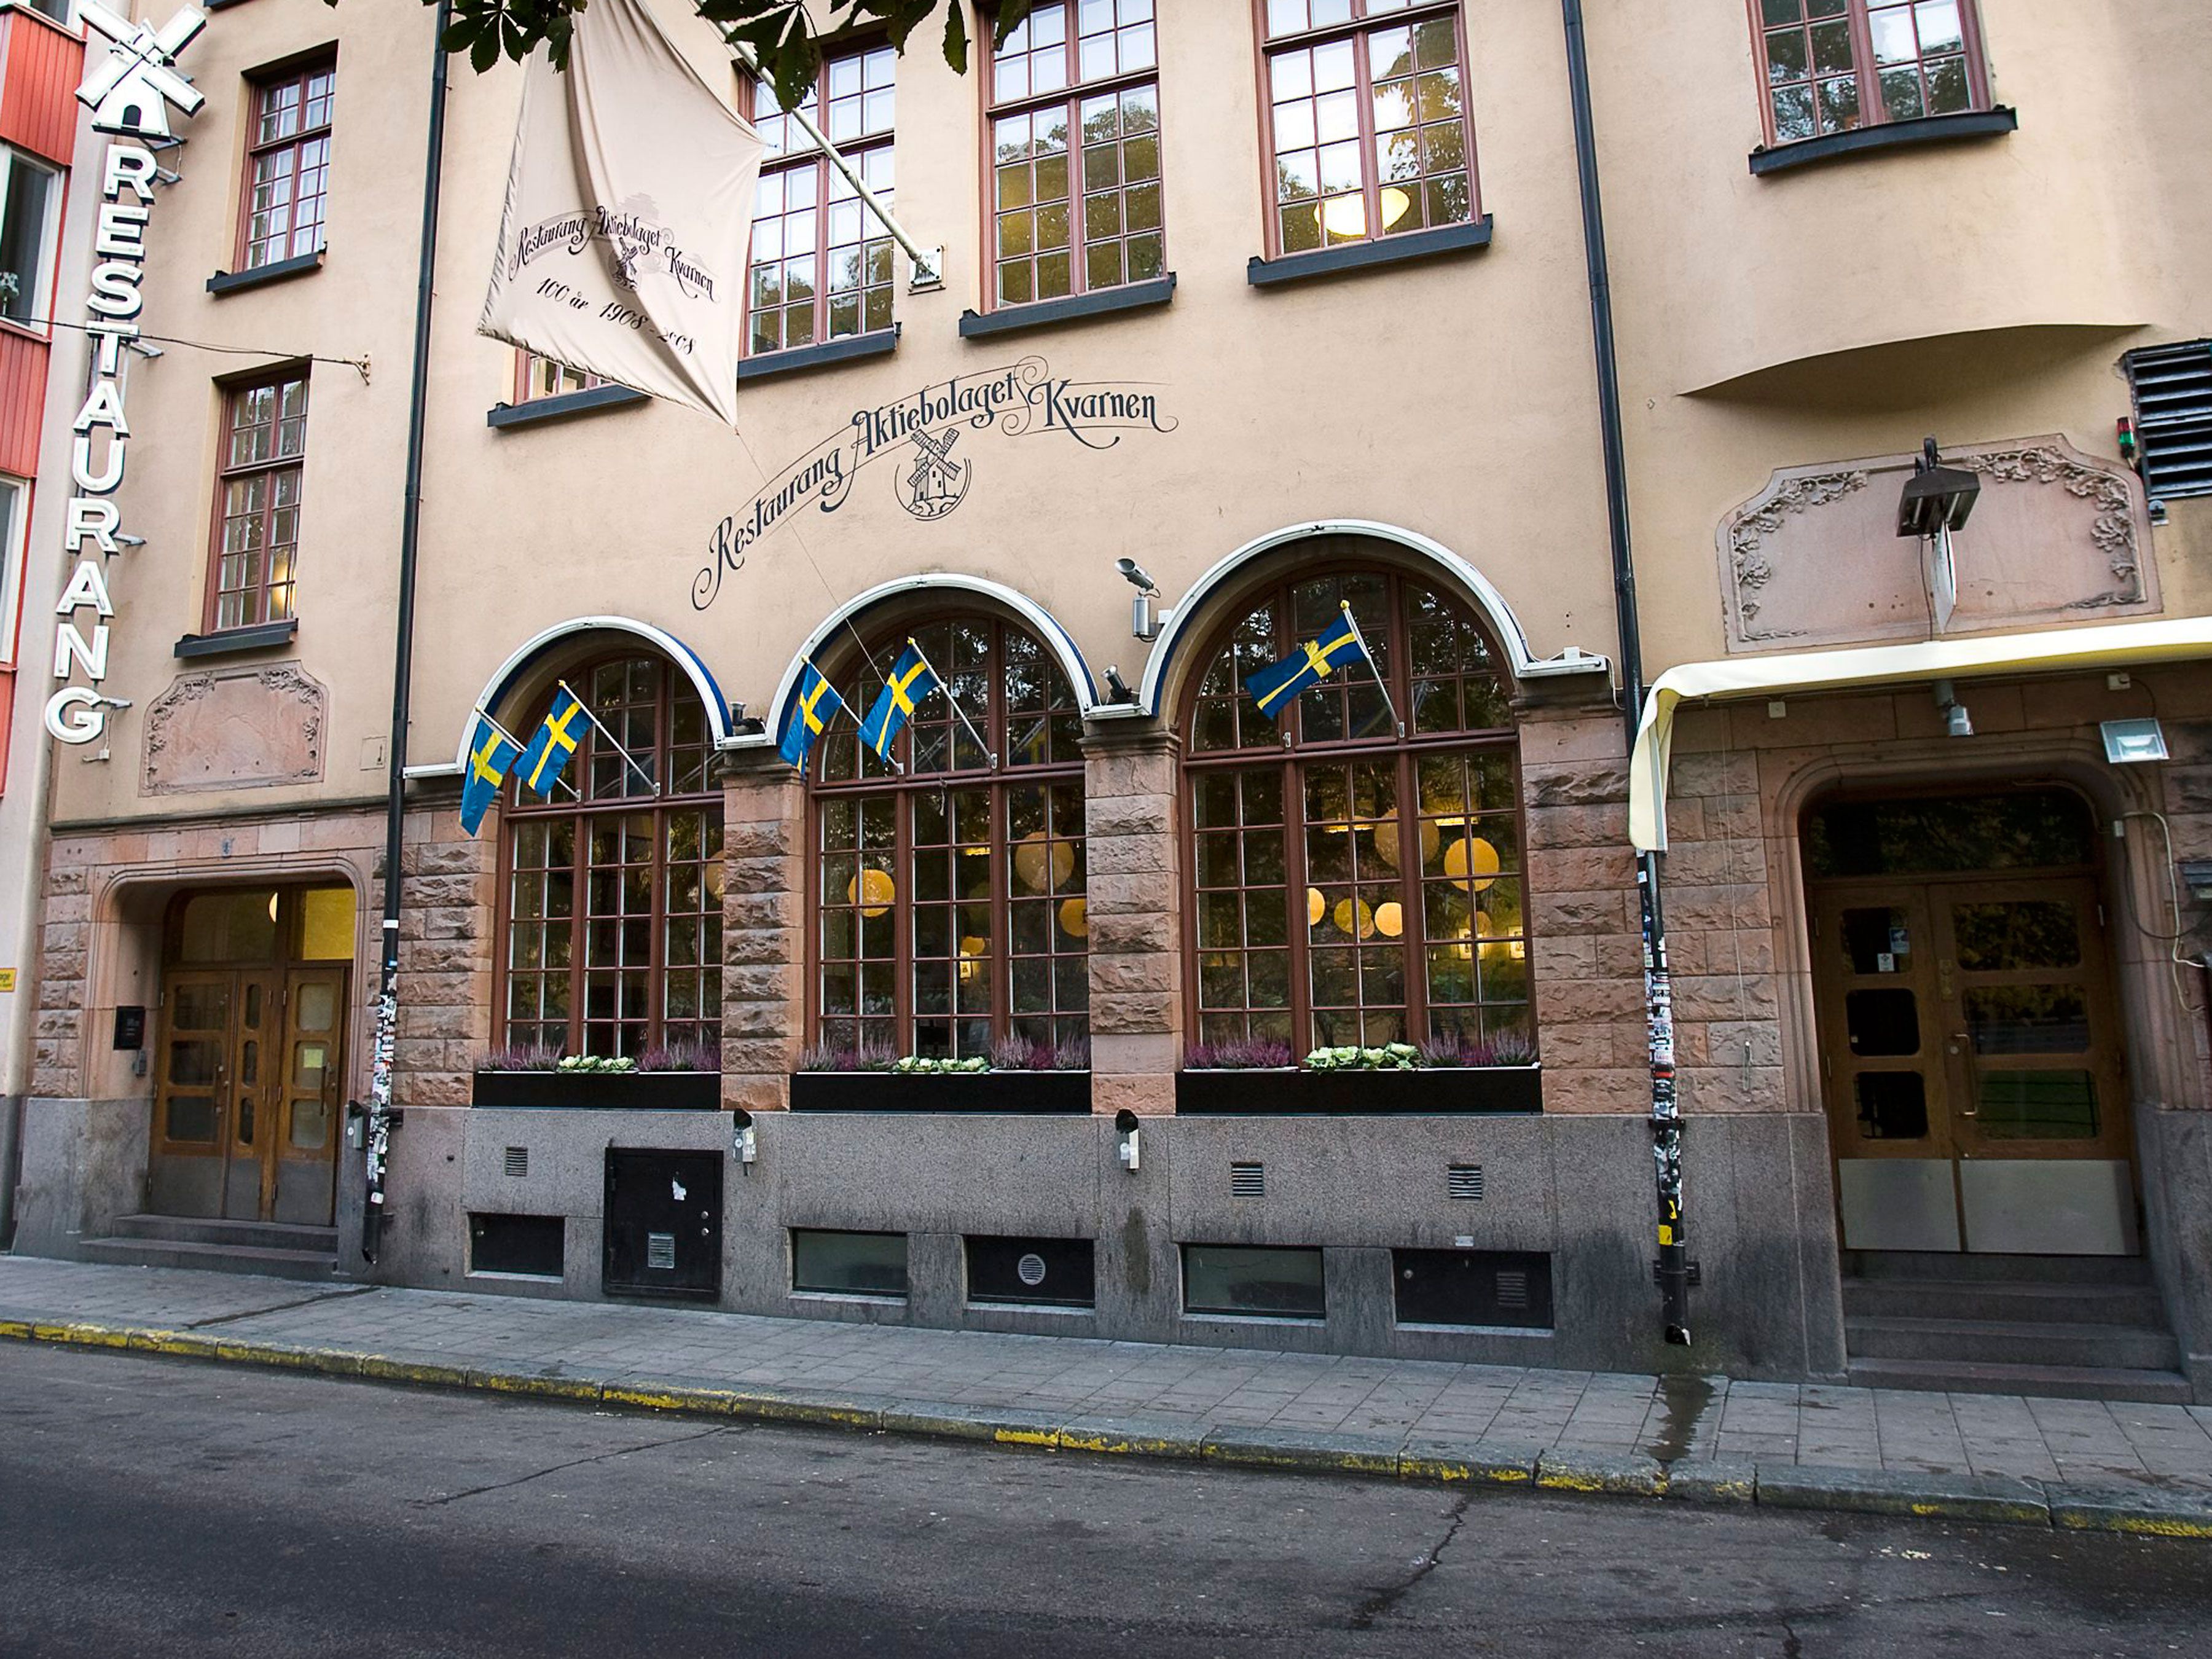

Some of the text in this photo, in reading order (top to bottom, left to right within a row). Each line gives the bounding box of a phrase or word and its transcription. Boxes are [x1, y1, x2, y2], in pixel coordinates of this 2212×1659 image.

[509, 217, 587, 281] Restaurang
[664, 246, 720, 303] Kvarnen
[536, 278, 570, 302] 100
[569, 291, 589, 310] år
[599, 302, 649, 330] 1908
[44, 143, 157, 745] RESTAURANG
[691, 371, 1179, 611] Restaurang Aktiebolaget Kvarnen
